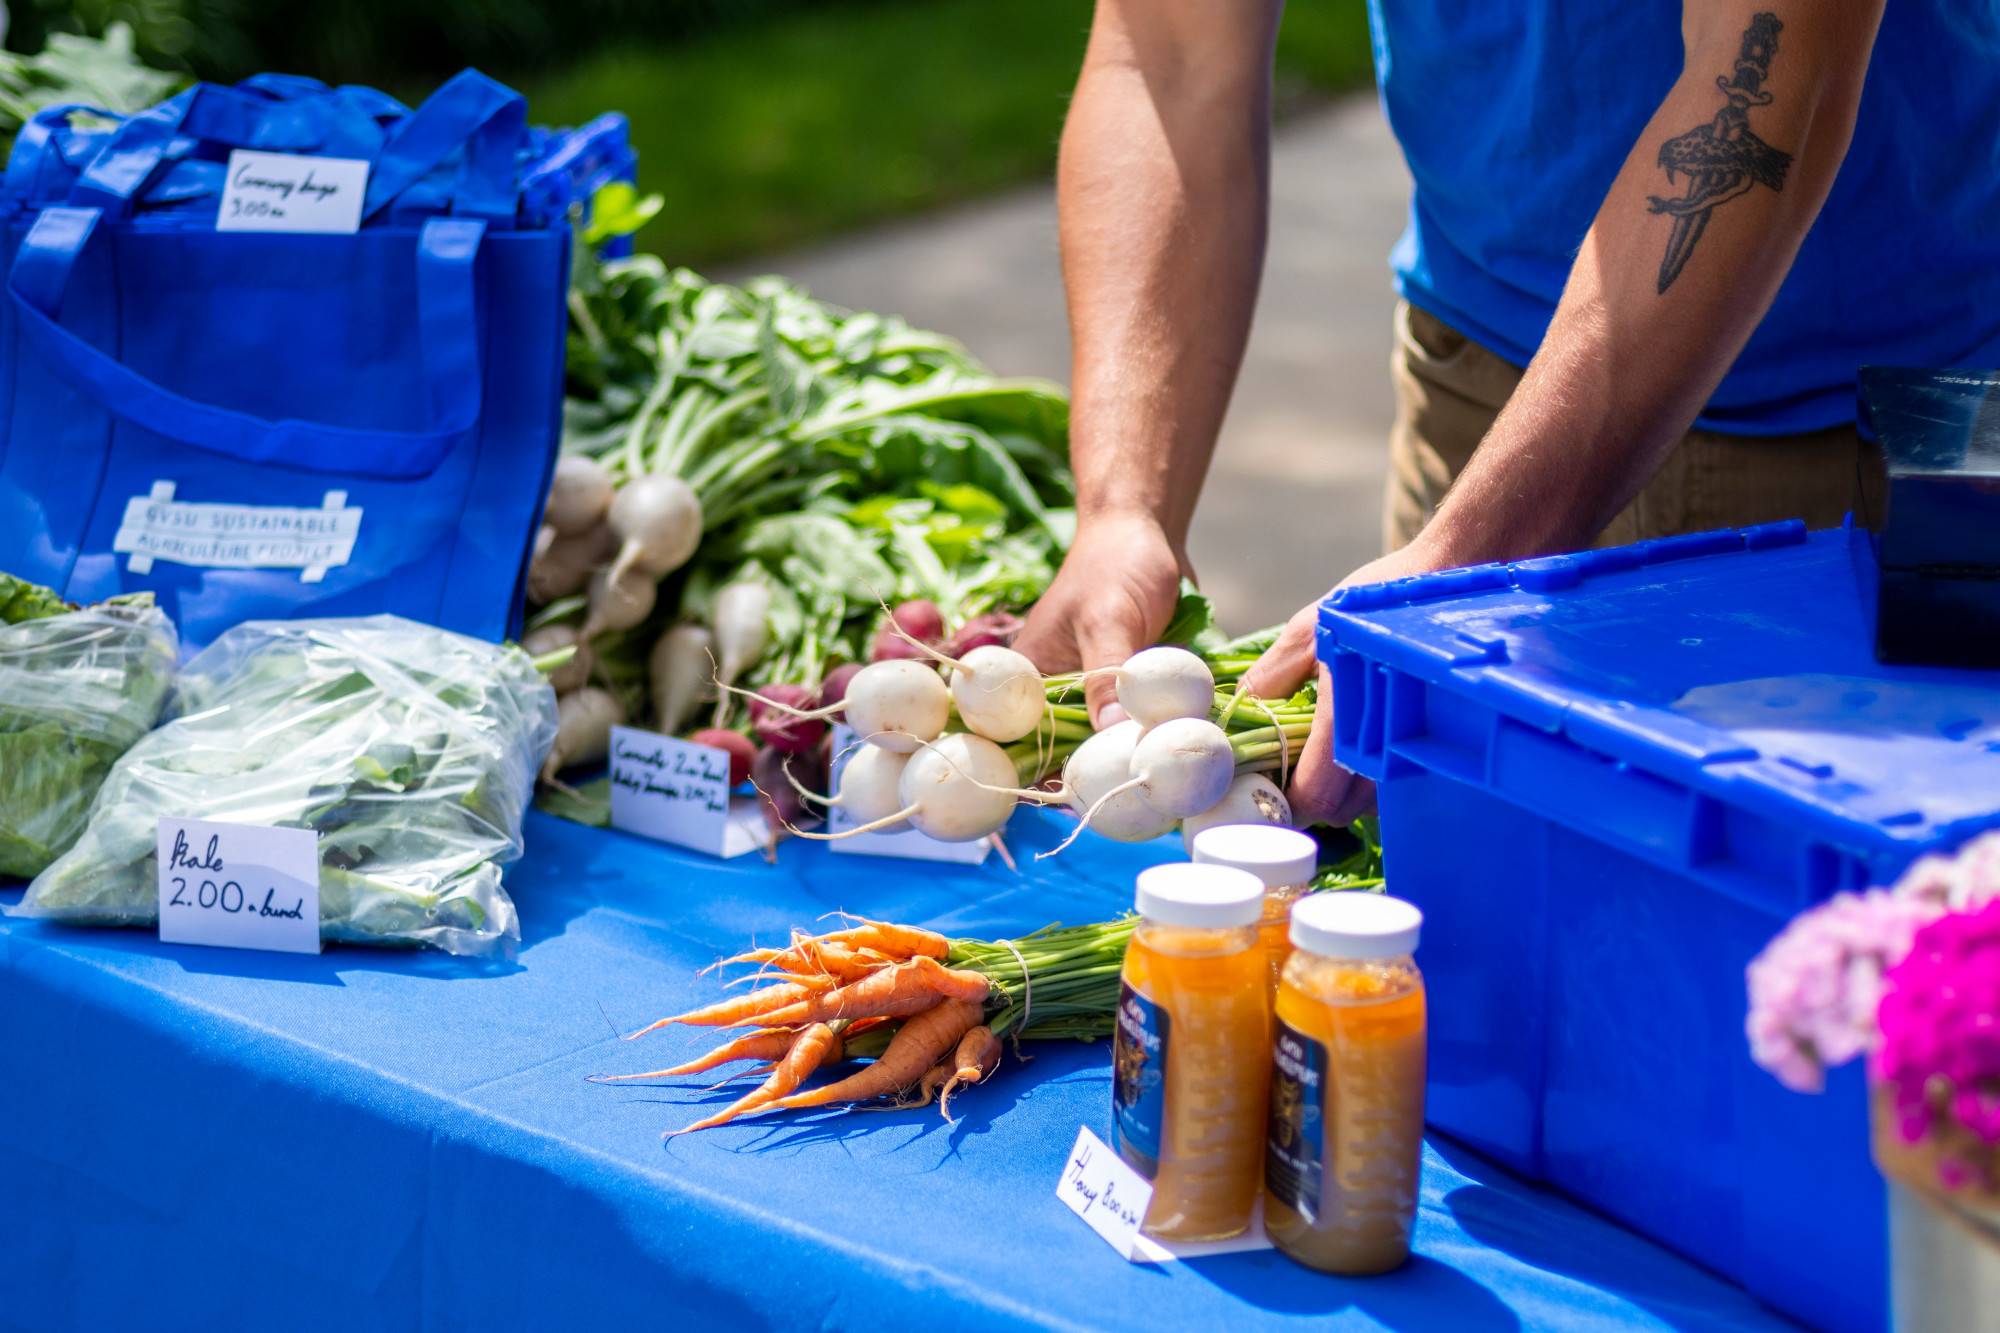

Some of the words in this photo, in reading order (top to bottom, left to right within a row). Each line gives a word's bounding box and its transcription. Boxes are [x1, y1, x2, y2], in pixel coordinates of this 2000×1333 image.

[211, 509, 338, 533] SUSTAINABLE
[170, 829, 223, 872] Kale
[170, 877, 244, 913] 2.00
[259, 888, 303, 920] bunch
